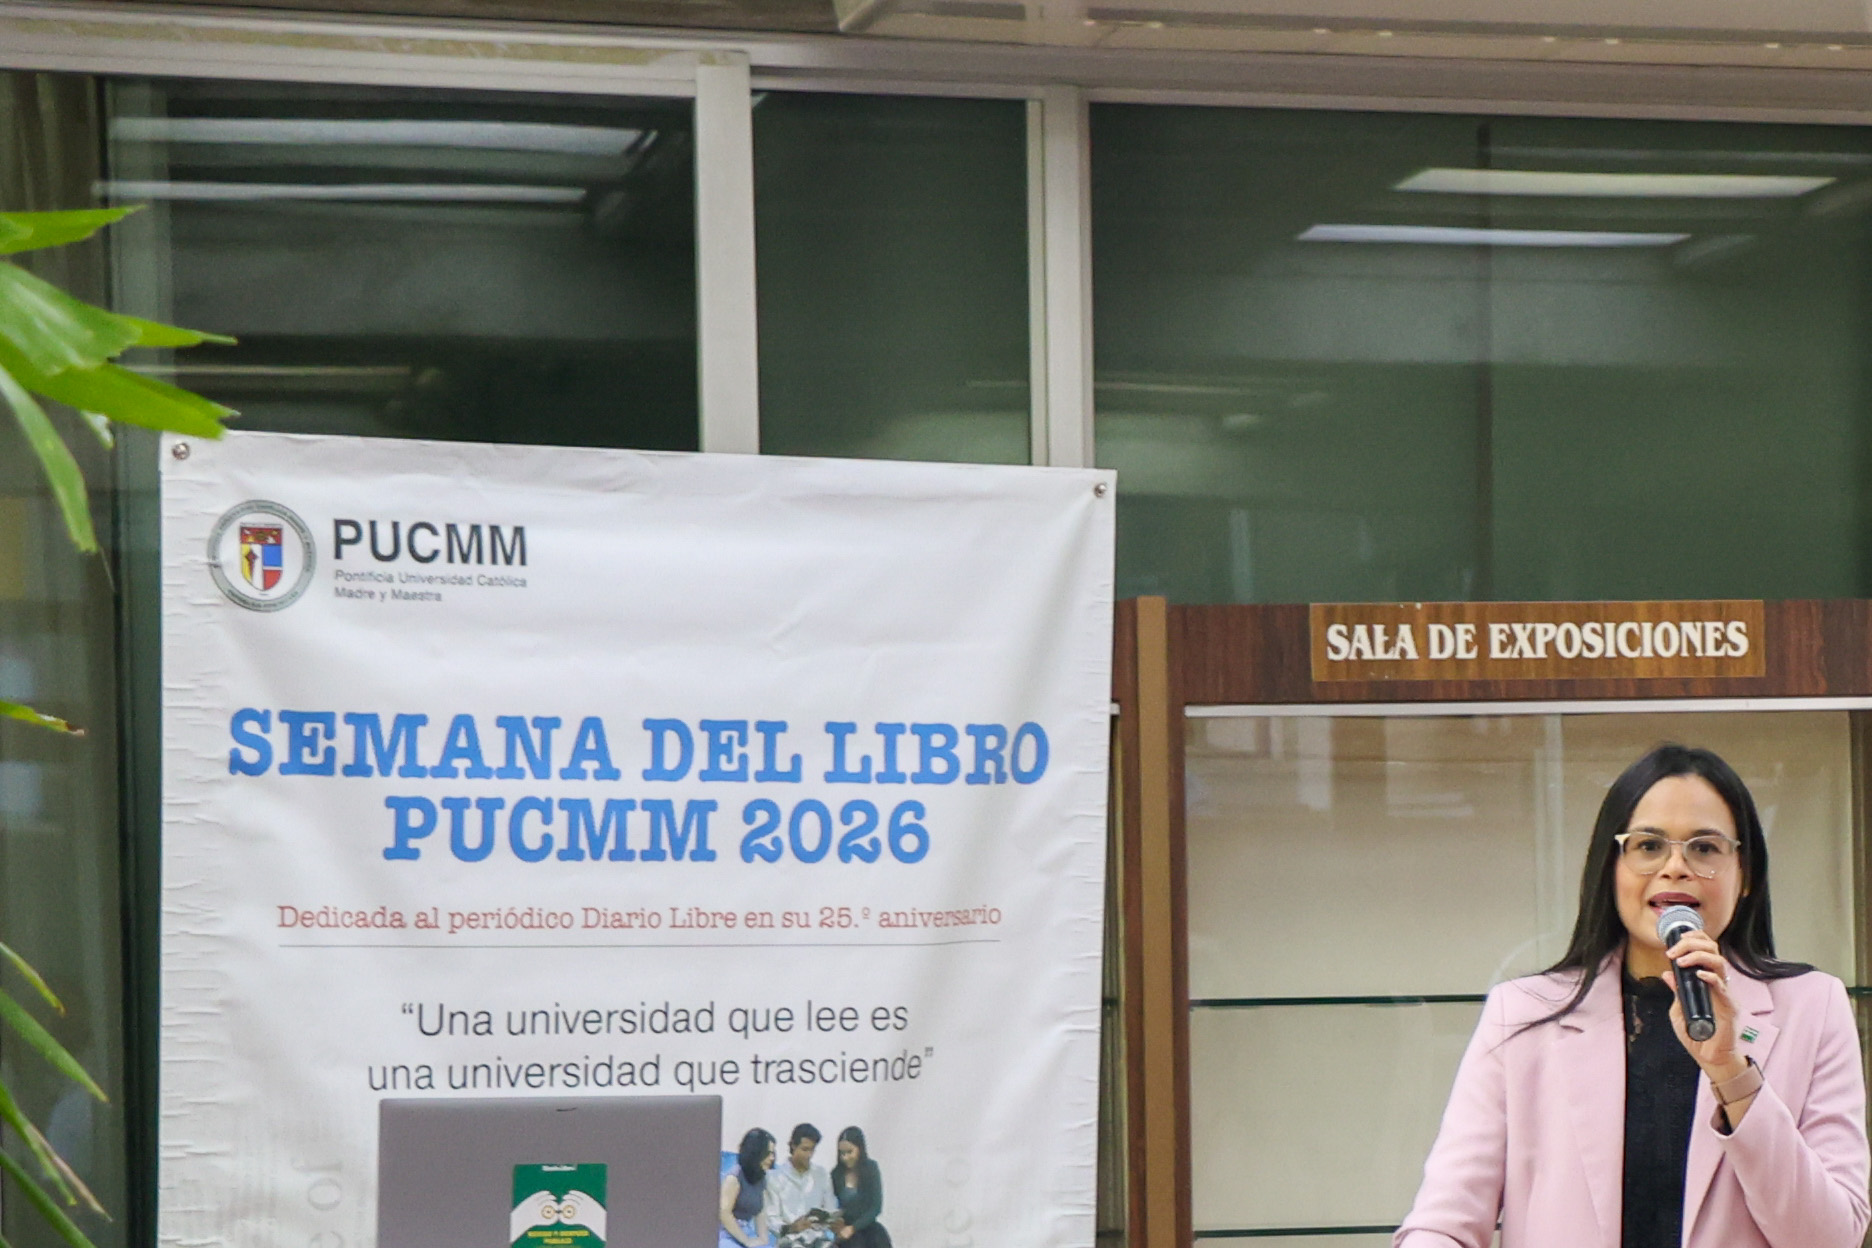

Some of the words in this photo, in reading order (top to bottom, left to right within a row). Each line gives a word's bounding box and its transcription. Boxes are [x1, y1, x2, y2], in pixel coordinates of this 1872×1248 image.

[333, 518, 527, 566] PUCMM
[334, 569, 394, 584] Pontificia
[398, 571, 473, 586] Universidad
[477, 573, 528, 588] Católica
[334, 587, 375, 600] Madre
[379, 591, 388, 603] y
[391, 588, 442, 602] Maestra
[1328, 624, 1418, 660] SALA
[1429, 624, 1477, 658] DE
[1489, 621, 1748, 658] EXPOSICIONES
[227, 707, 622, 781] SEMANA
[642, 718, 803, 784] DEL
[823, 721, 1050, 785] LIBRO
[382, 795, 718, 863] PUCMM
[740, 798, 930, 864] 2026
[277, 905, 408, 929] Dedicada
[413, 907, 440, 929] al
[448, 907, 574, 934] periódico
[581, 907, 661, 929] Diario
[669, 907, 737, 929] Libre
[745, 911, 775, 929] en
[781, 911, 811, 928] su
[879, 905, 1001, 928] aniversario
[507, 1001, 714, 1036] universidad
[729, 1007, 794, 1040] que
[808, 1000, 859, 1032] lee
[871, 1006, 908, 1031] es
[368, 1065, 435, 1091] una
[448, 1054, 660, 1090] universidad
[674, 1060, 740, 1093] que
